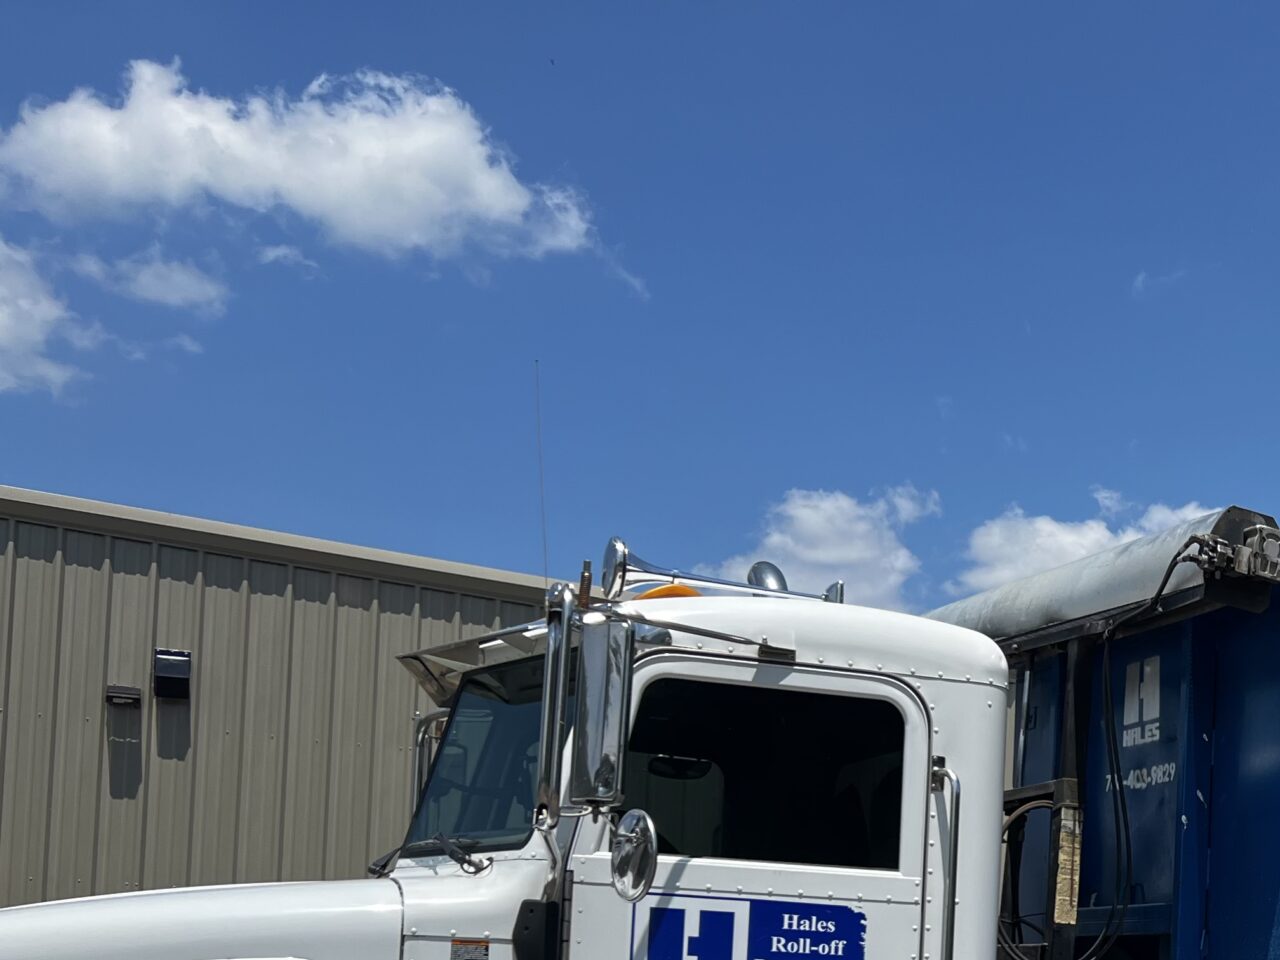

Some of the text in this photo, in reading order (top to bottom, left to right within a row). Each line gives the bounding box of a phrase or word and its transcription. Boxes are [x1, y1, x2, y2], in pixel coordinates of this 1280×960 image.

[1122, 722, 1160, 747] HALES
[1105, 762, 1176, 791] 7-403-9829
[782, 913, 836, 933] Hales
[770, 936, 847, 956] Roll-off
